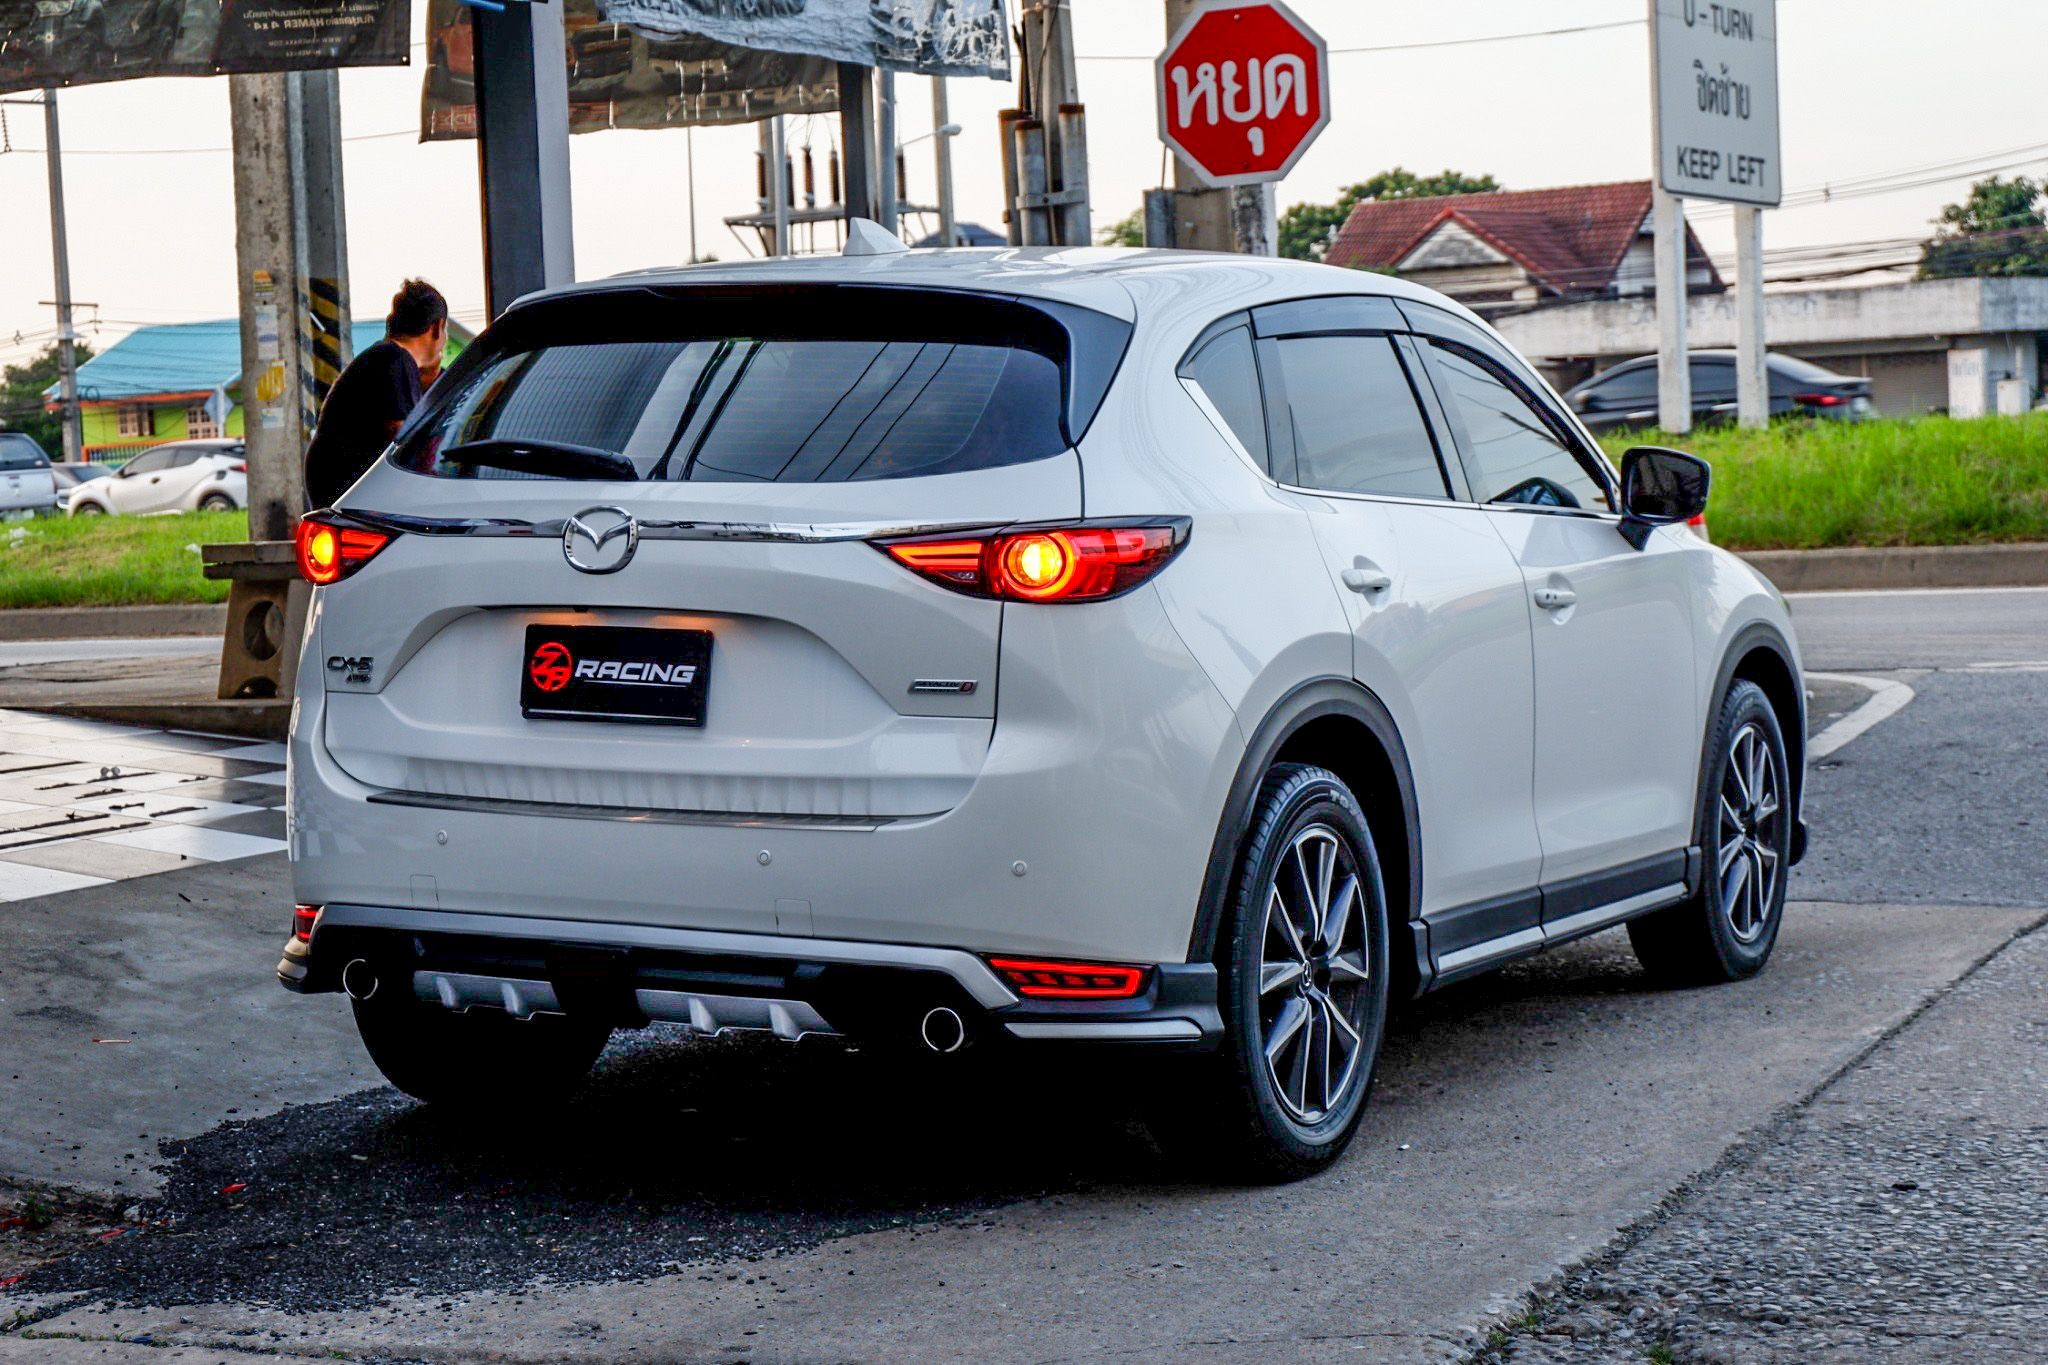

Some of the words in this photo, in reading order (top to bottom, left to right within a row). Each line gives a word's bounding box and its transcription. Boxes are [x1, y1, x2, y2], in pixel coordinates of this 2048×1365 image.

[1683, 0, 1753, 42] U-TURN
[1171, 53, 1308, 156] หยุด
[1677, 145, 1720, 181] KEEP
[1728, 152, 1766, 187] LEFT
[574, 659, 697, 683] RACING
